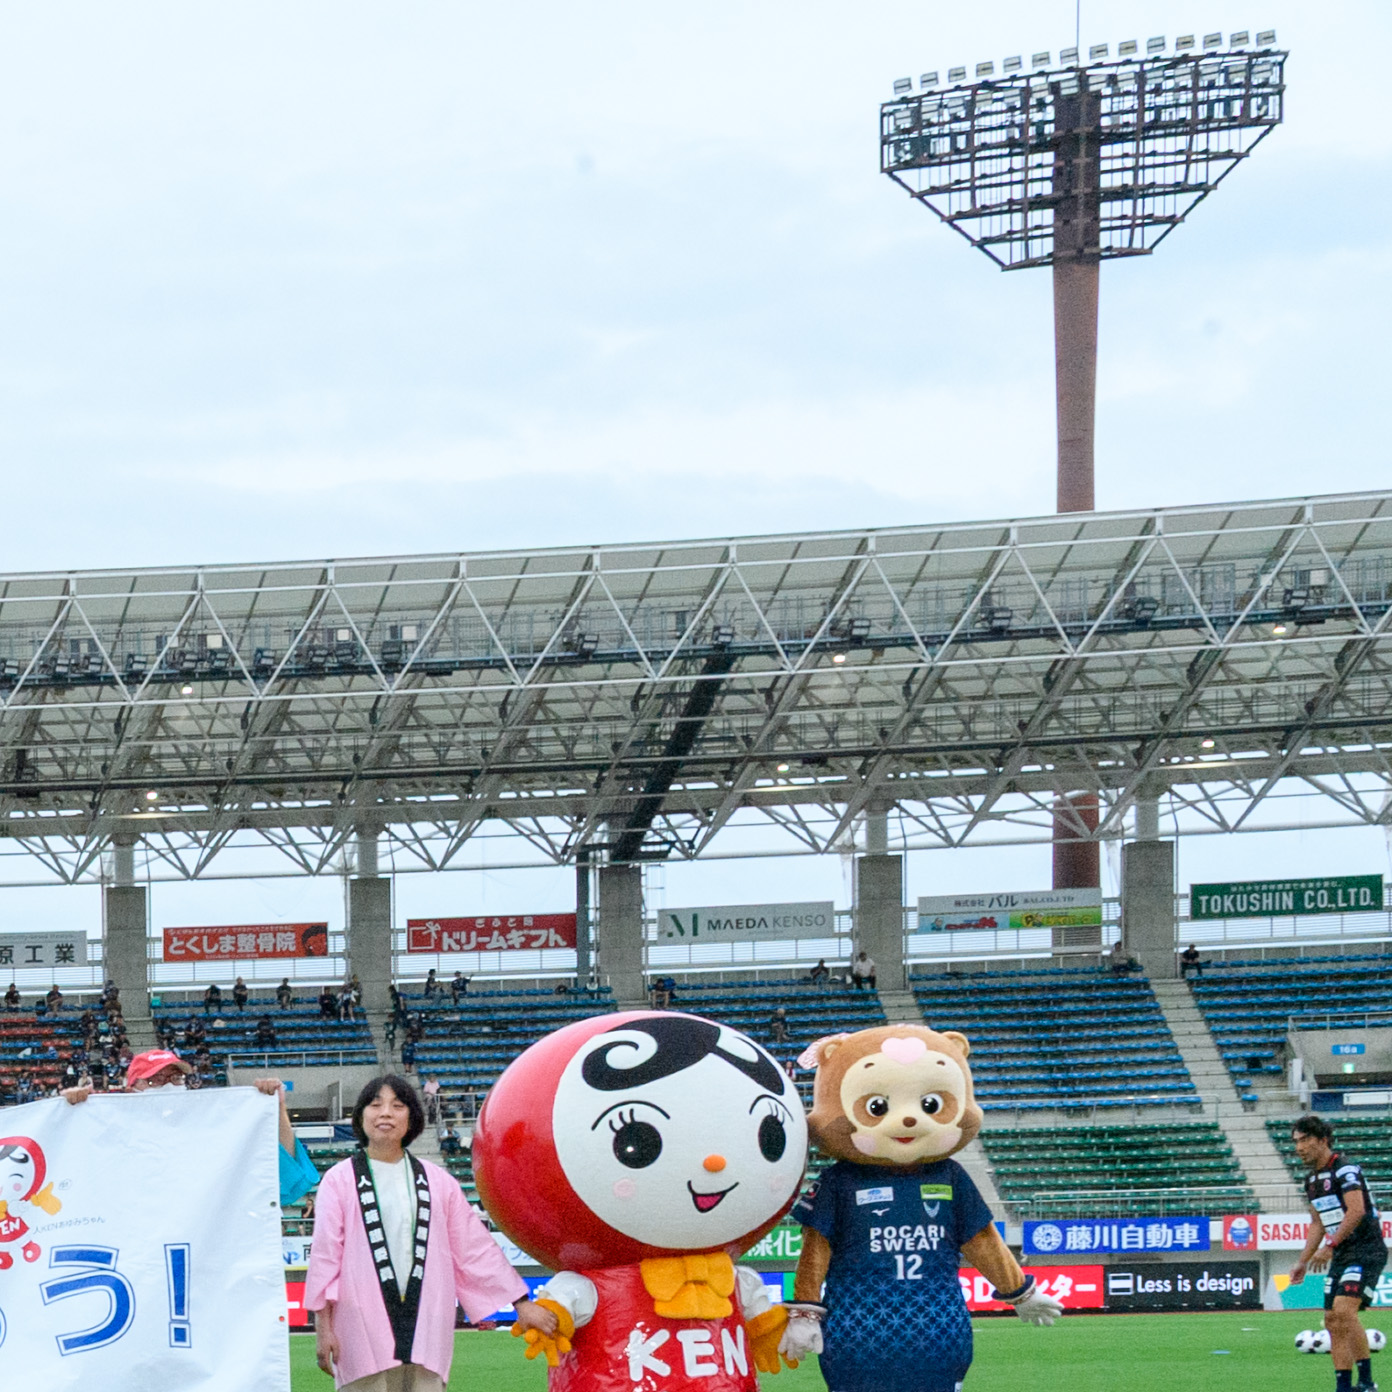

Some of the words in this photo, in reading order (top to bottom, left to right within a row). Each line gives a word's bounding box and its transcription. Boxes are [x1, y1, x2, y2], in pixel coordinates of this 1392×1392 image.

[1198, 891, 1294, 914] TOKUSHIN
[707, 917, 769, 931] MAEDA
[772, 914, 826, 929] KENSO
[168, 931, 297, 955] とくしま整骨院
[870, 1225, 945, 1240] POCARI
[1065, 1223, 1200, 1250] 藤川自動車
[870, 1237, 941, 1253] SWEAT
[894, 1254, 923, 1281] 12
[1137, 1275, 1172, 1293] Less
[1178, 1274, 1191, 1292] is
[1196, 1270, 1254, 1295] design
[628, 1324, 749, 1382] KEN
